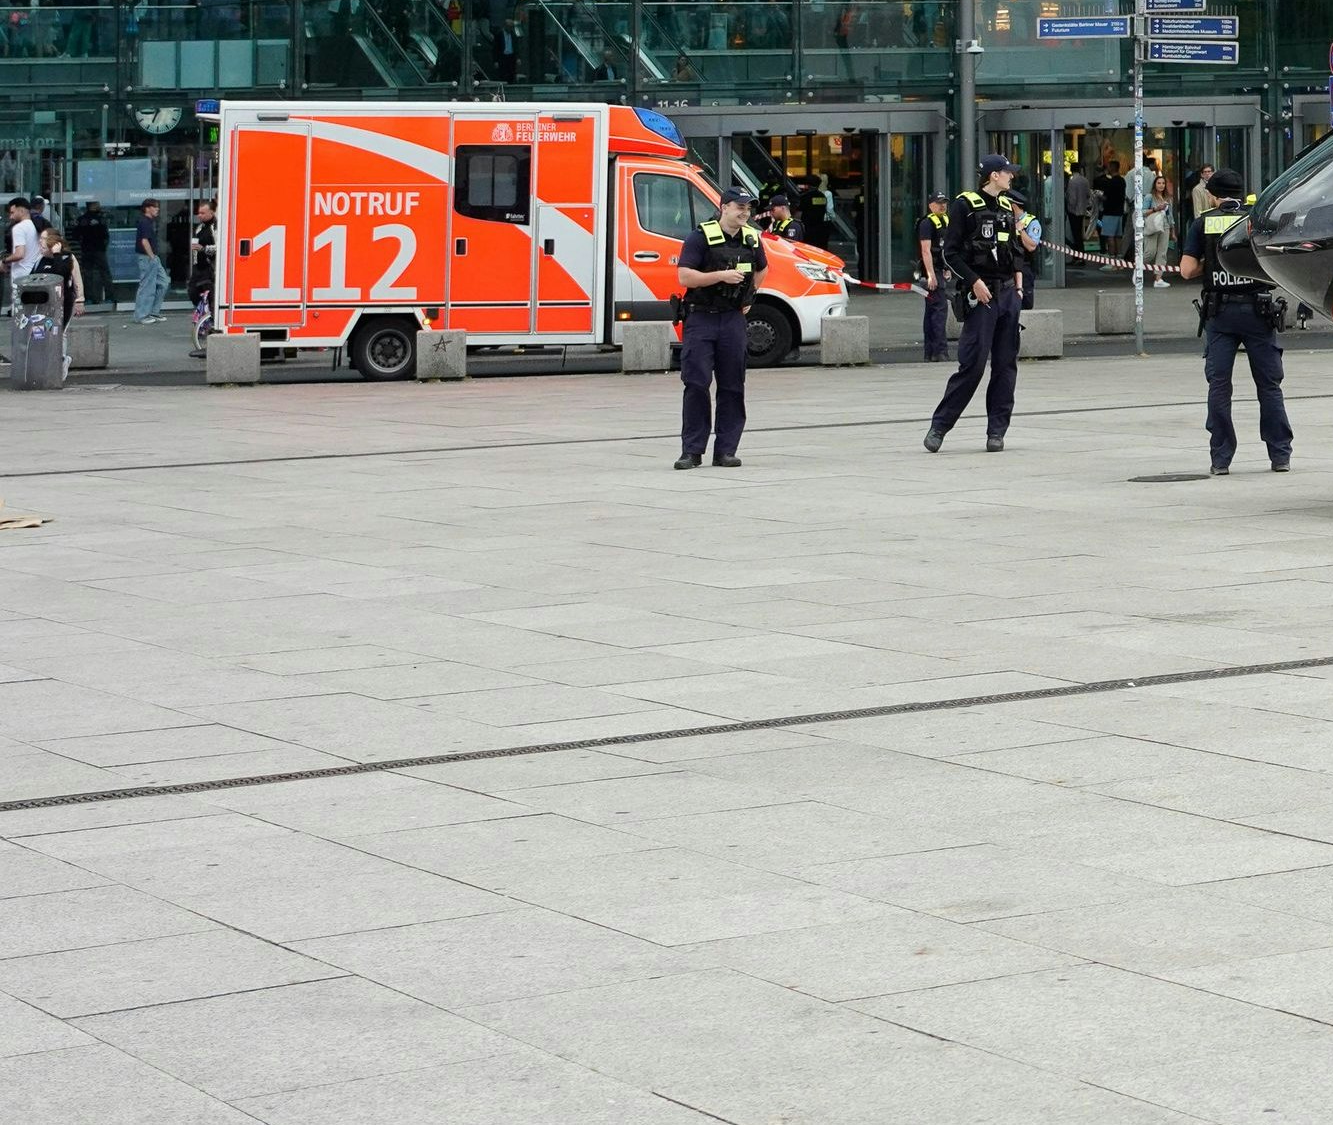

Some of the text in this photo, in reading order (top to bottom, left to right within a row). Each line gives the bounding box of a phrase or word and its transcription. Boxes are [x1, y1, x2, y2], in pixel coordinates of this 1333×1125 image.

[516, 122, 557, 131] BERLINER
[516, 132, 577, 142] FEUERWEHR
[314, 191, 420, 217] NOTRUF
[250, 223, 418, 302] 112
